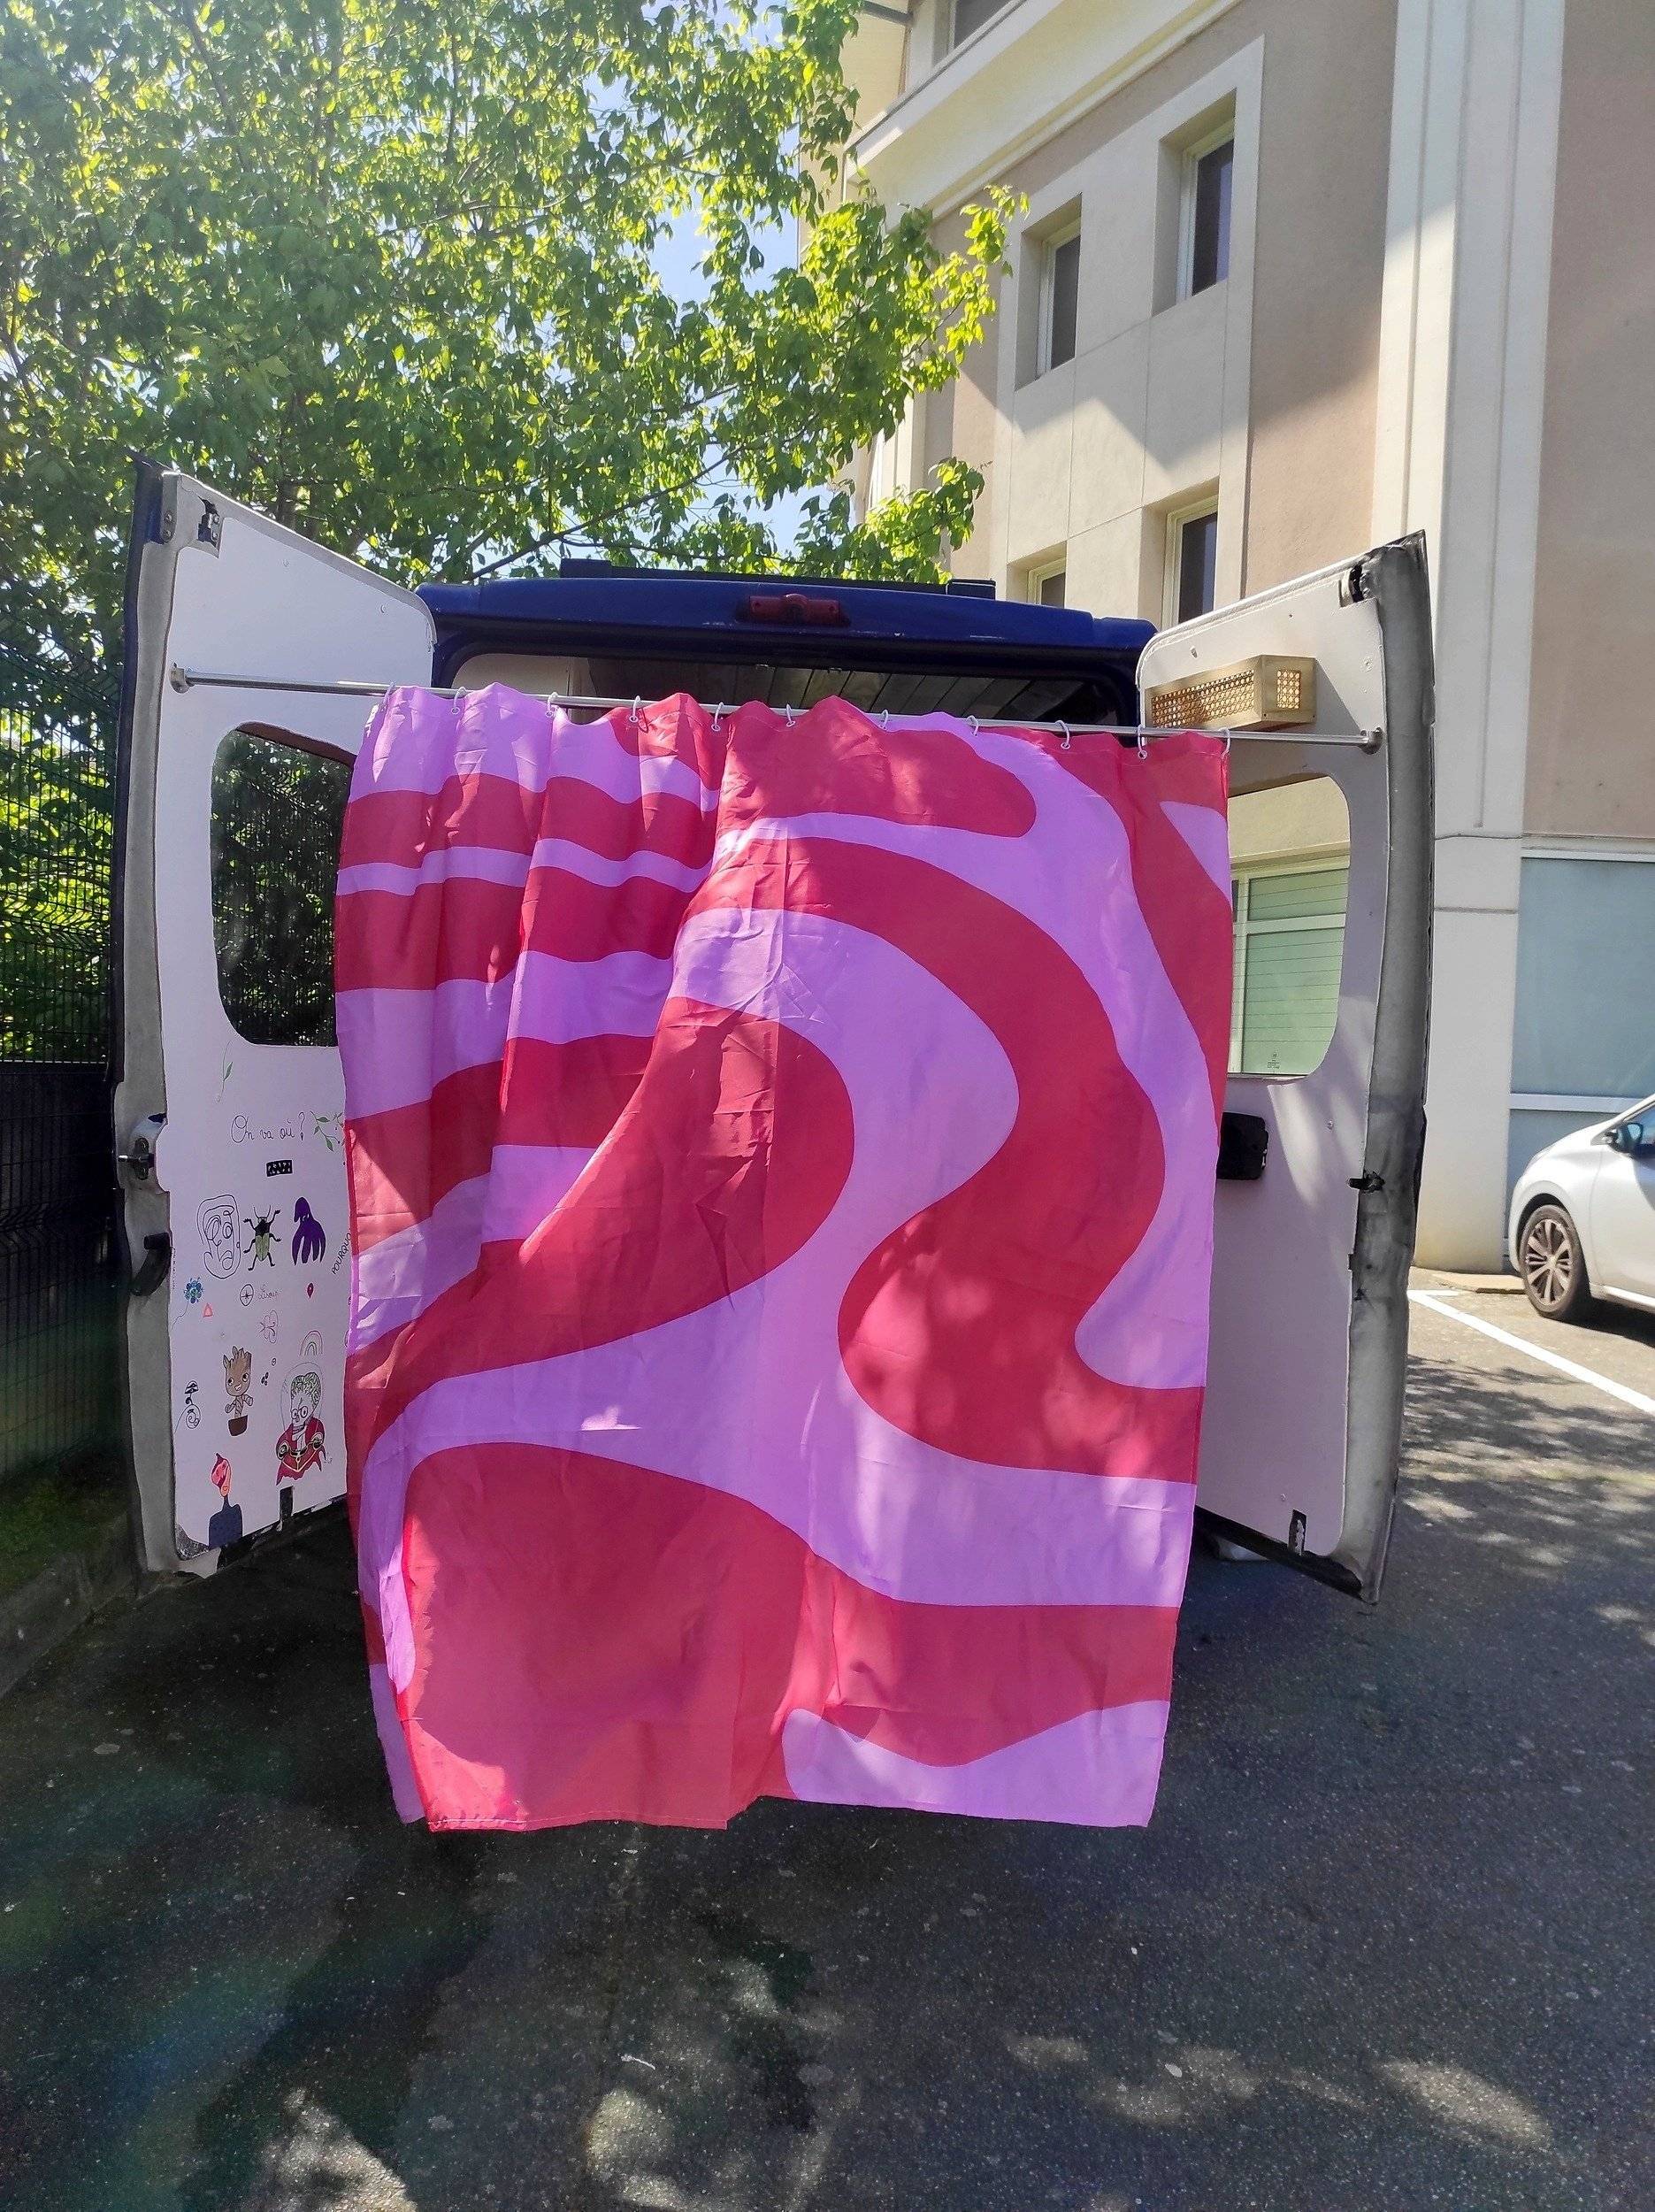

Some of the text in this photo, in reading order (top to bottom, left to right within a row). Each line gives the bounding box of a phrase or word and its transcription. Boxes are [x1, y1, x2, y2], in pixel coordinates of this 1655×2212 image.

[231, 1114, 255, 1144] On
[259, 1129, 273, 1141] va
[331, 1230, 352, 1275] POURQUO
